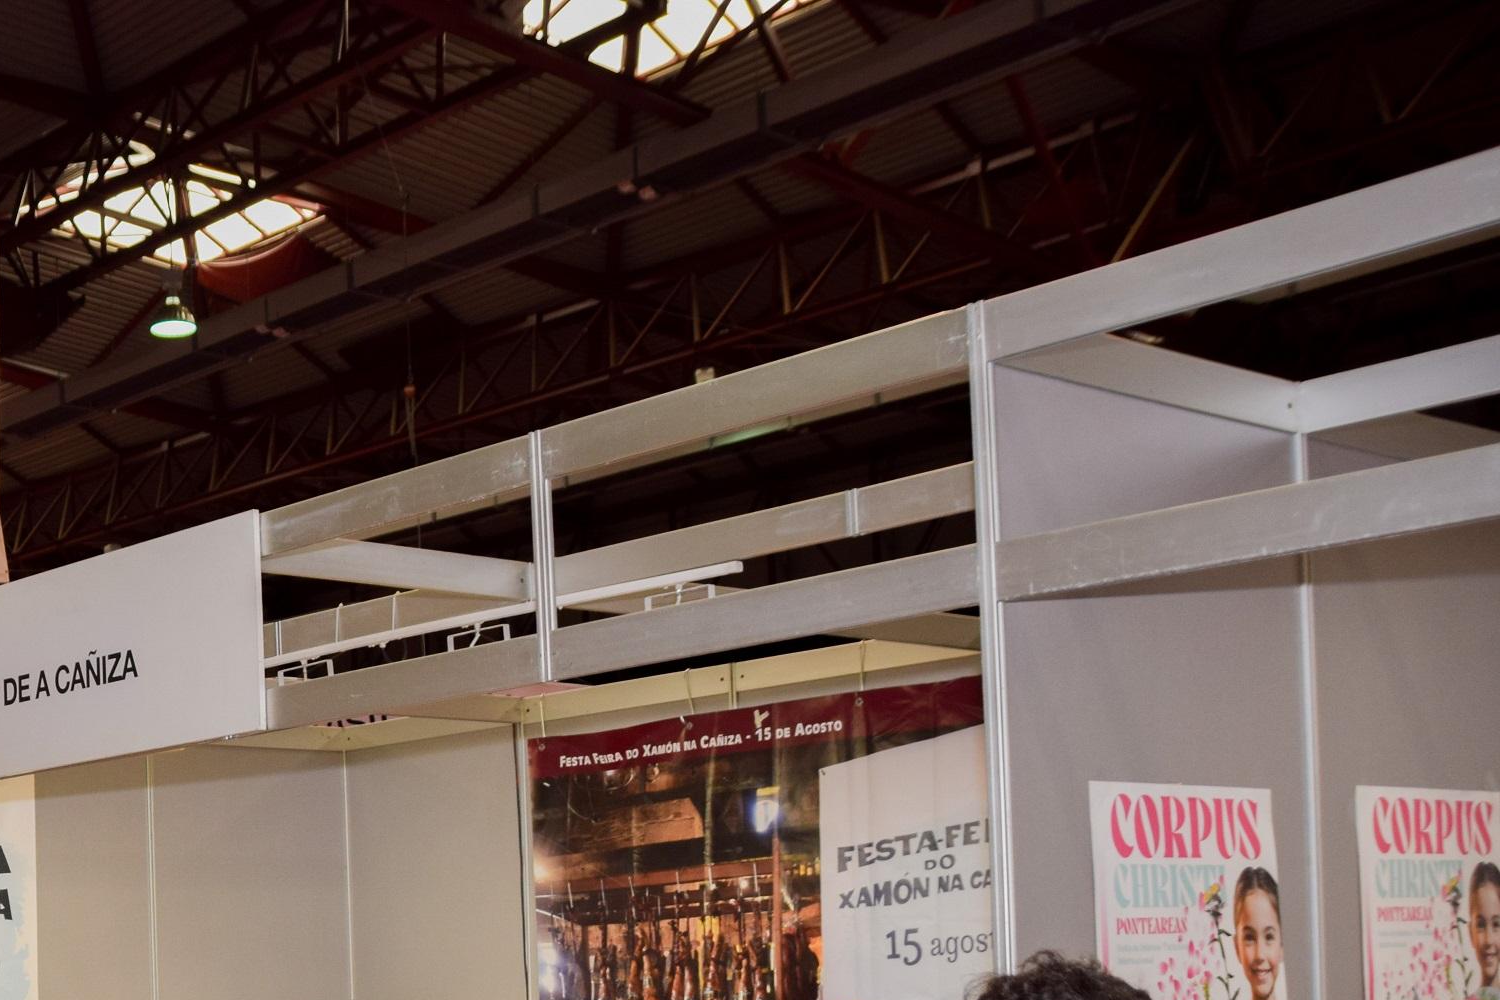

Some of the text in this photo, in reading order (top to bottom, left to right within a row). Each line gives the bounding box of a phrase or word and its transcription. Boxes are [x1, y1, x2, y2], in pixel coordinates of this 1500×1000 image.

[3, 673, 31, 706] DE
[34, 671, 51, 698] A
[55, 649, 138, 693] CAÑIZA
[755, 728, 772, 742] 15
[1110, 793, 1262, 860] CORPUS
[1372, 795, 1493, 857] CORPUS
[924, 854, 956, 870] DO
[839, 872, 930, 909] XAMÓN
[937, 874, 964, 893] NA
[1116, 916, 1188, 935] PONTEAREAS
[885, 928, 922, 966] 15
